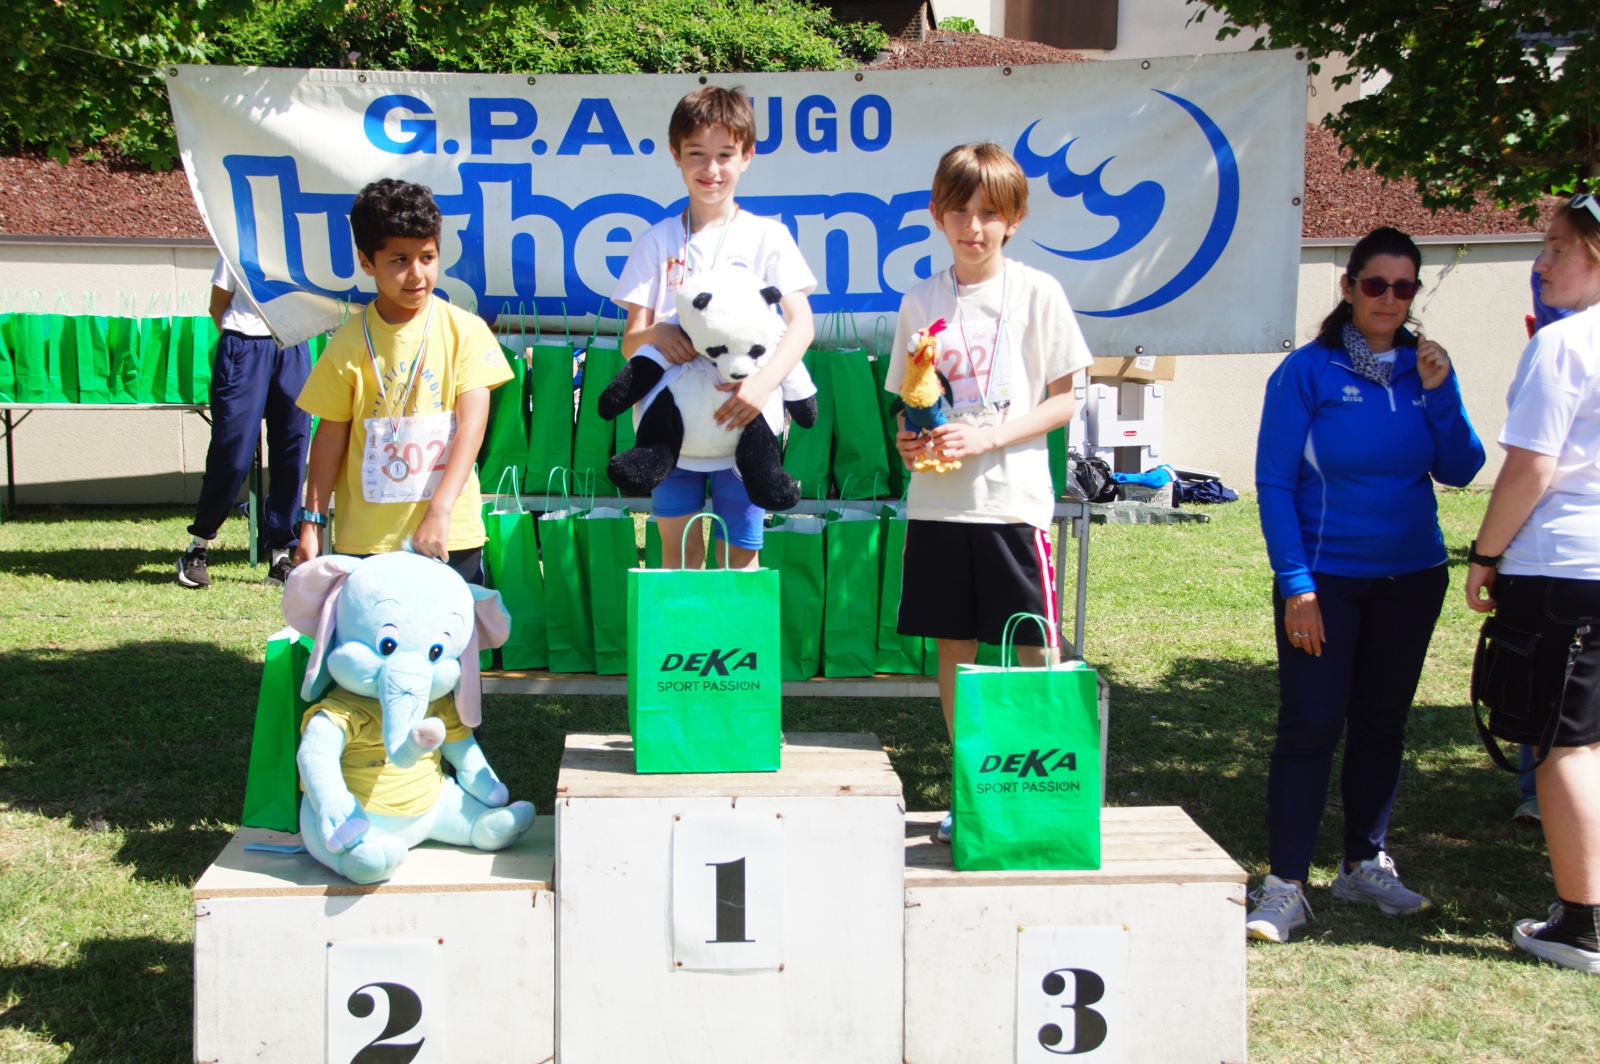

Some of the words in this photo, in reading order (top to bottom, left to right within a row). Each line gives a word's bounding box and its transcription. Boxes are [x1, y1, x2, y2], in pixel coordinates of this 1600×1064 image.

[363, 94, 656, 155] G.P.A.
[750, 94, 892, 155] UGO
[935, 345, 991, 383] 22
[660, 648, 757, 676] DEKA
[657, 681, 699, 692] SPORT
[703, 680, 760, 691] PASSION
[979, 748, 1077, 778] DEKA
[977, 782, 1018, 794] SPORT
[1022, 781, 1080, 793] PASSION
[705, 856, 756, 943] 1
[347, 982, 426, 1064] 2
[1038, 967, 1108, 1055] 3
